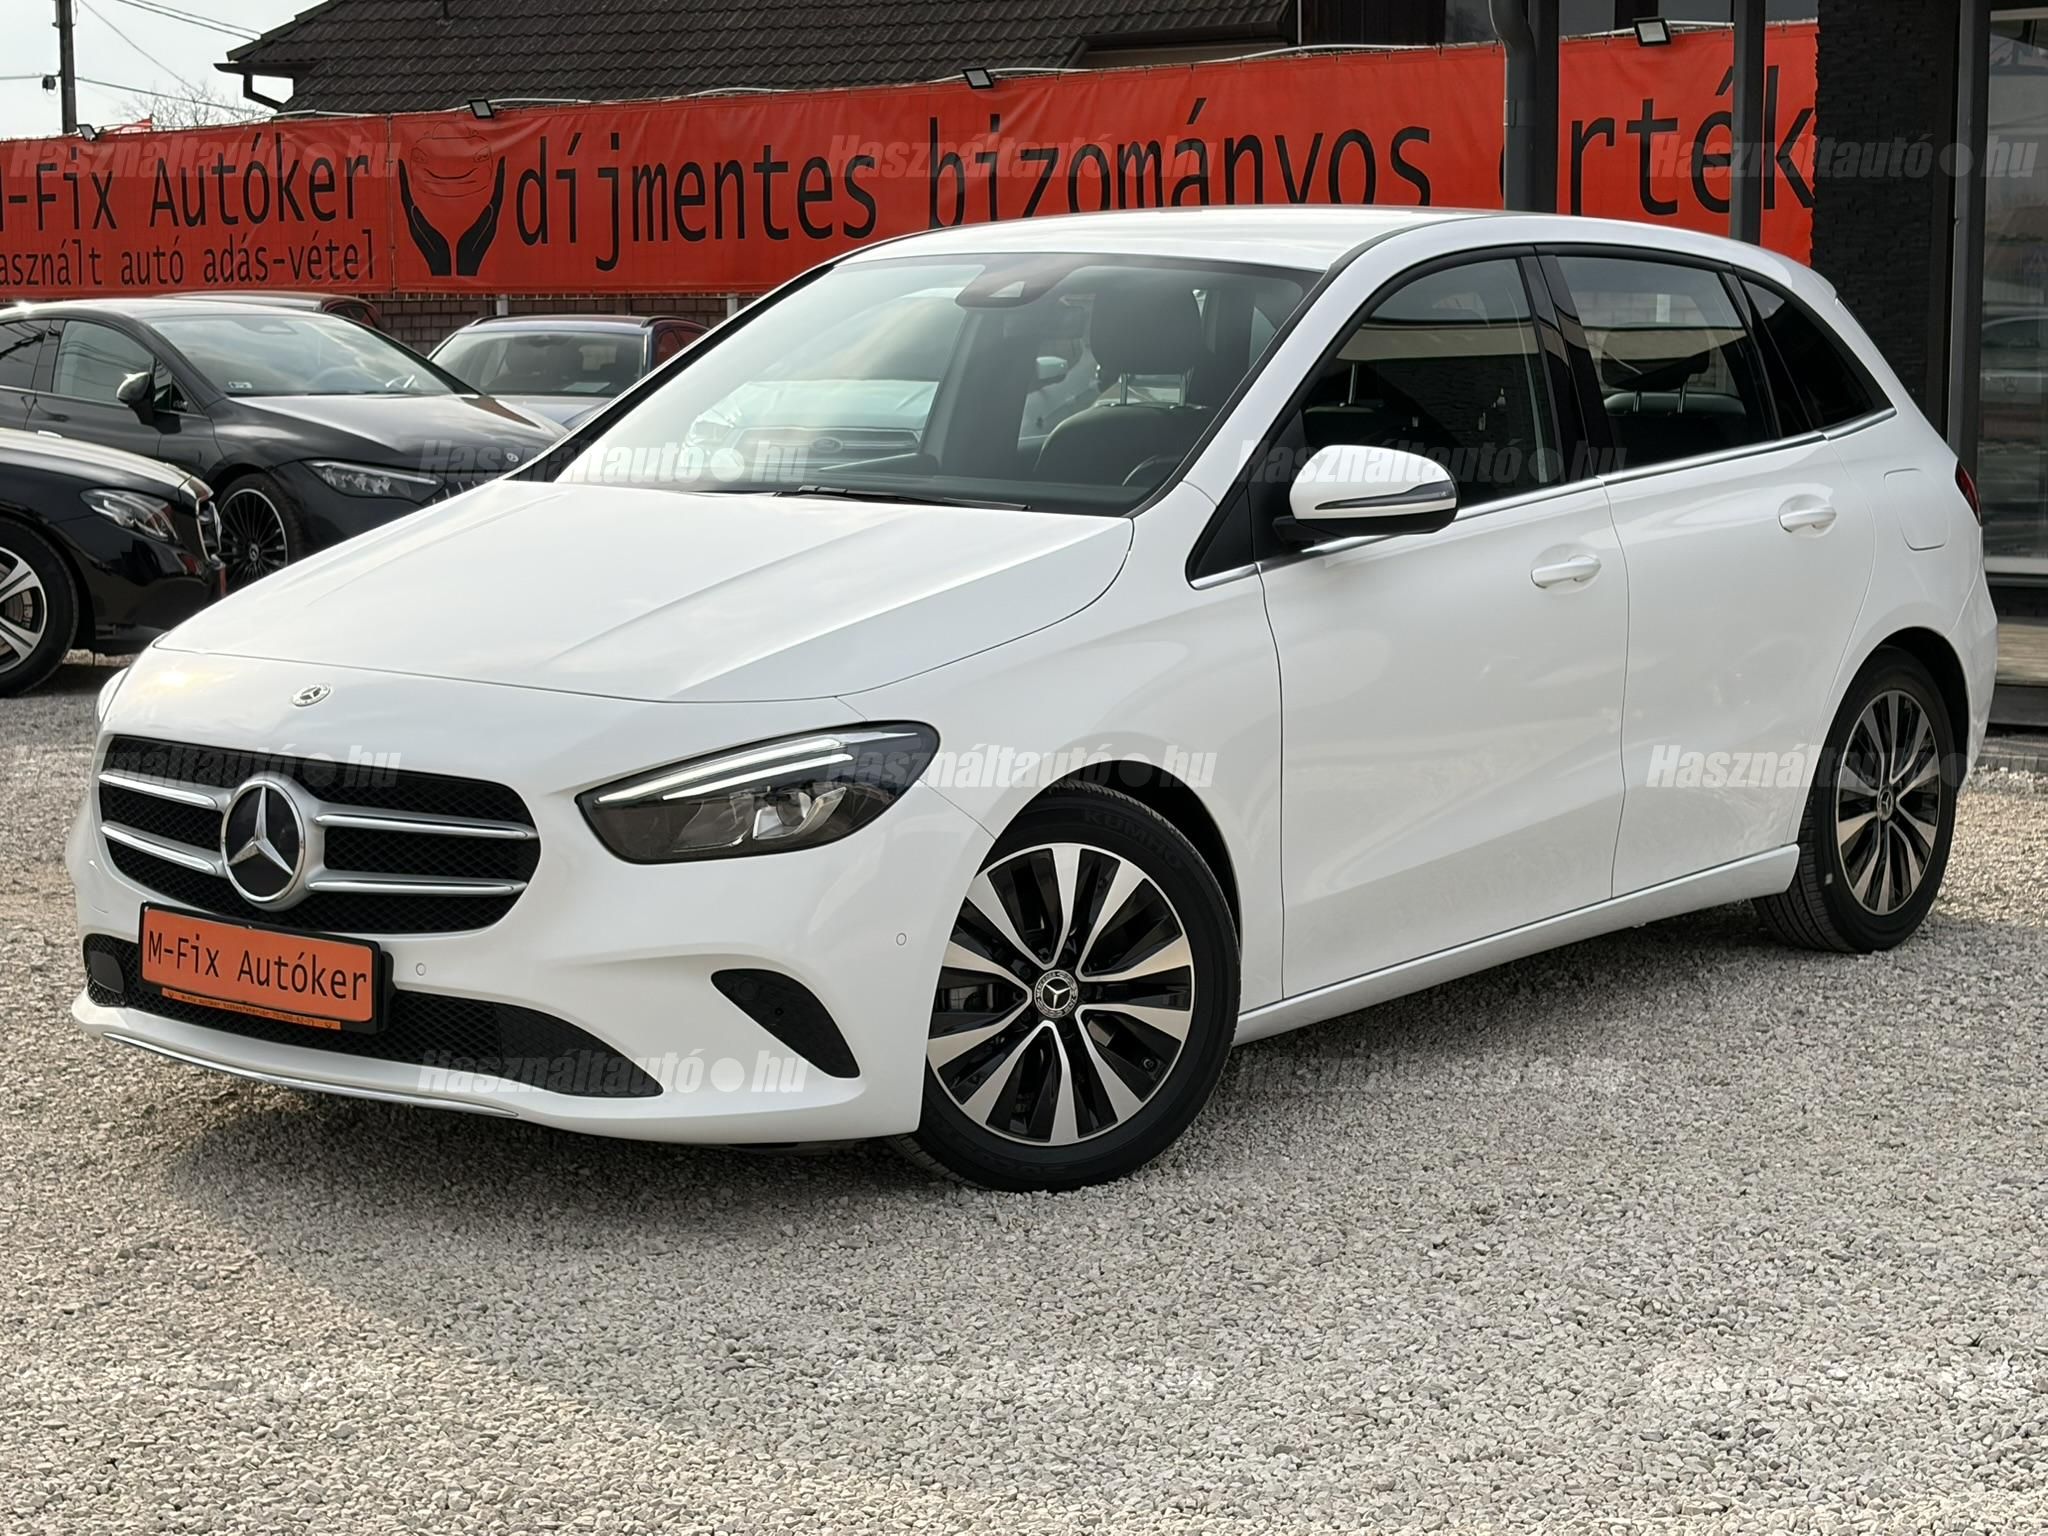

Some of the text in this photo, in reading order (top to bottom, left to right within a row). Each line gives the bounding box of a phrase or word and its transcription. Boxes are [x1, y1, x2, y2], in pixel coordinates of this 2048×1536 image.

[0, 132, 369, 231] -Fix Autóker
[516, 65, 1815, 271] díjmentes bizományos rték
[121, 235, 184, 285] autó
[203, 229, 374, 283] adás-vétel
[148, 931, 367, 1001] M-Fix Autóker
